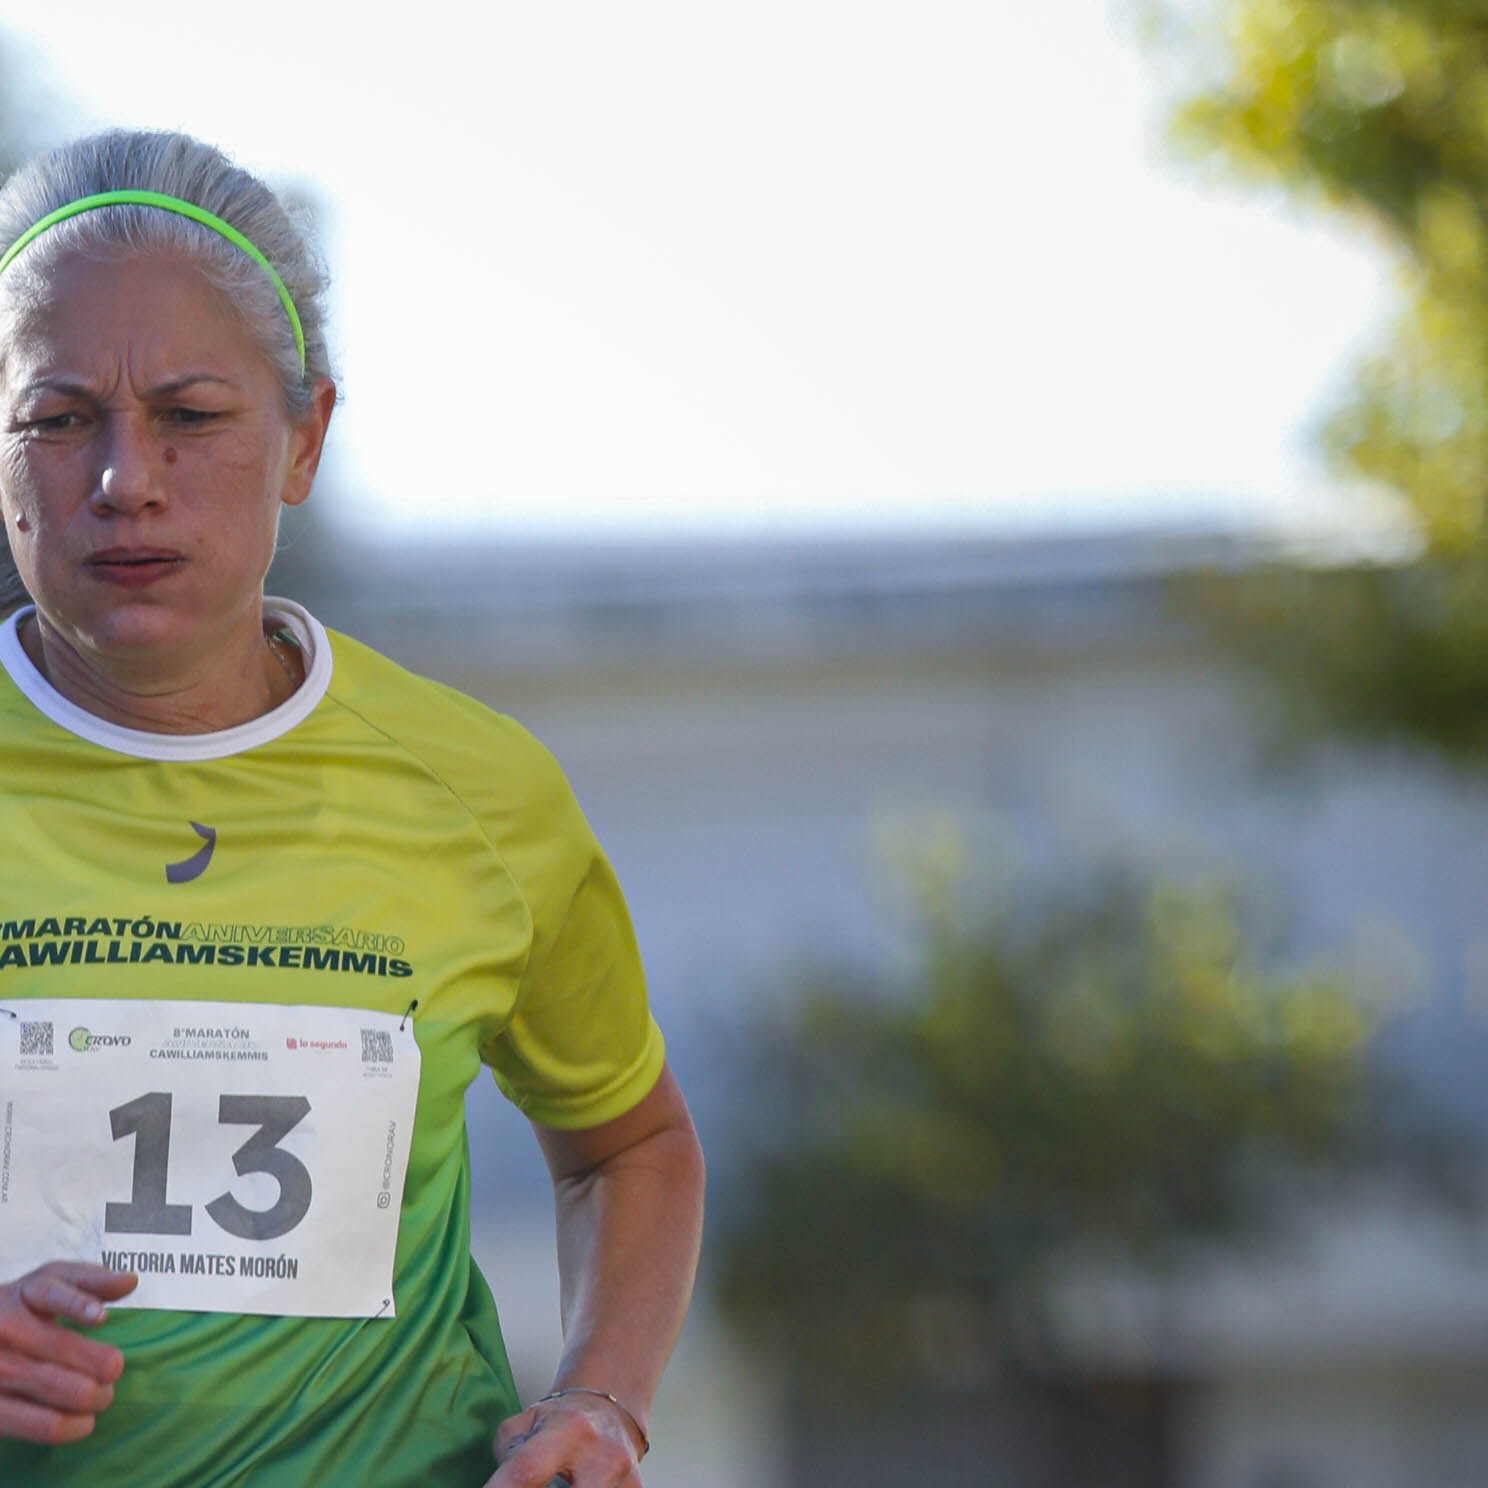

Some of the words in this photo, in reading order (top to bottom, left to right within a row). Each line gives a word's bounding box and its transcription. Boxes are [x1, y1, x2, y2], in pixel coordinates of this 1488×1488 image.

[149, 1048, 269, 1061] CAWILLIAMSKEMMIS
[104, 1091, 312, 1241] 13
[101, 1250, 176, 1274] VICTORIA
[179, 1253, 236, 1277] MATES
[239, 1253, 299, 1280] MORÓN
